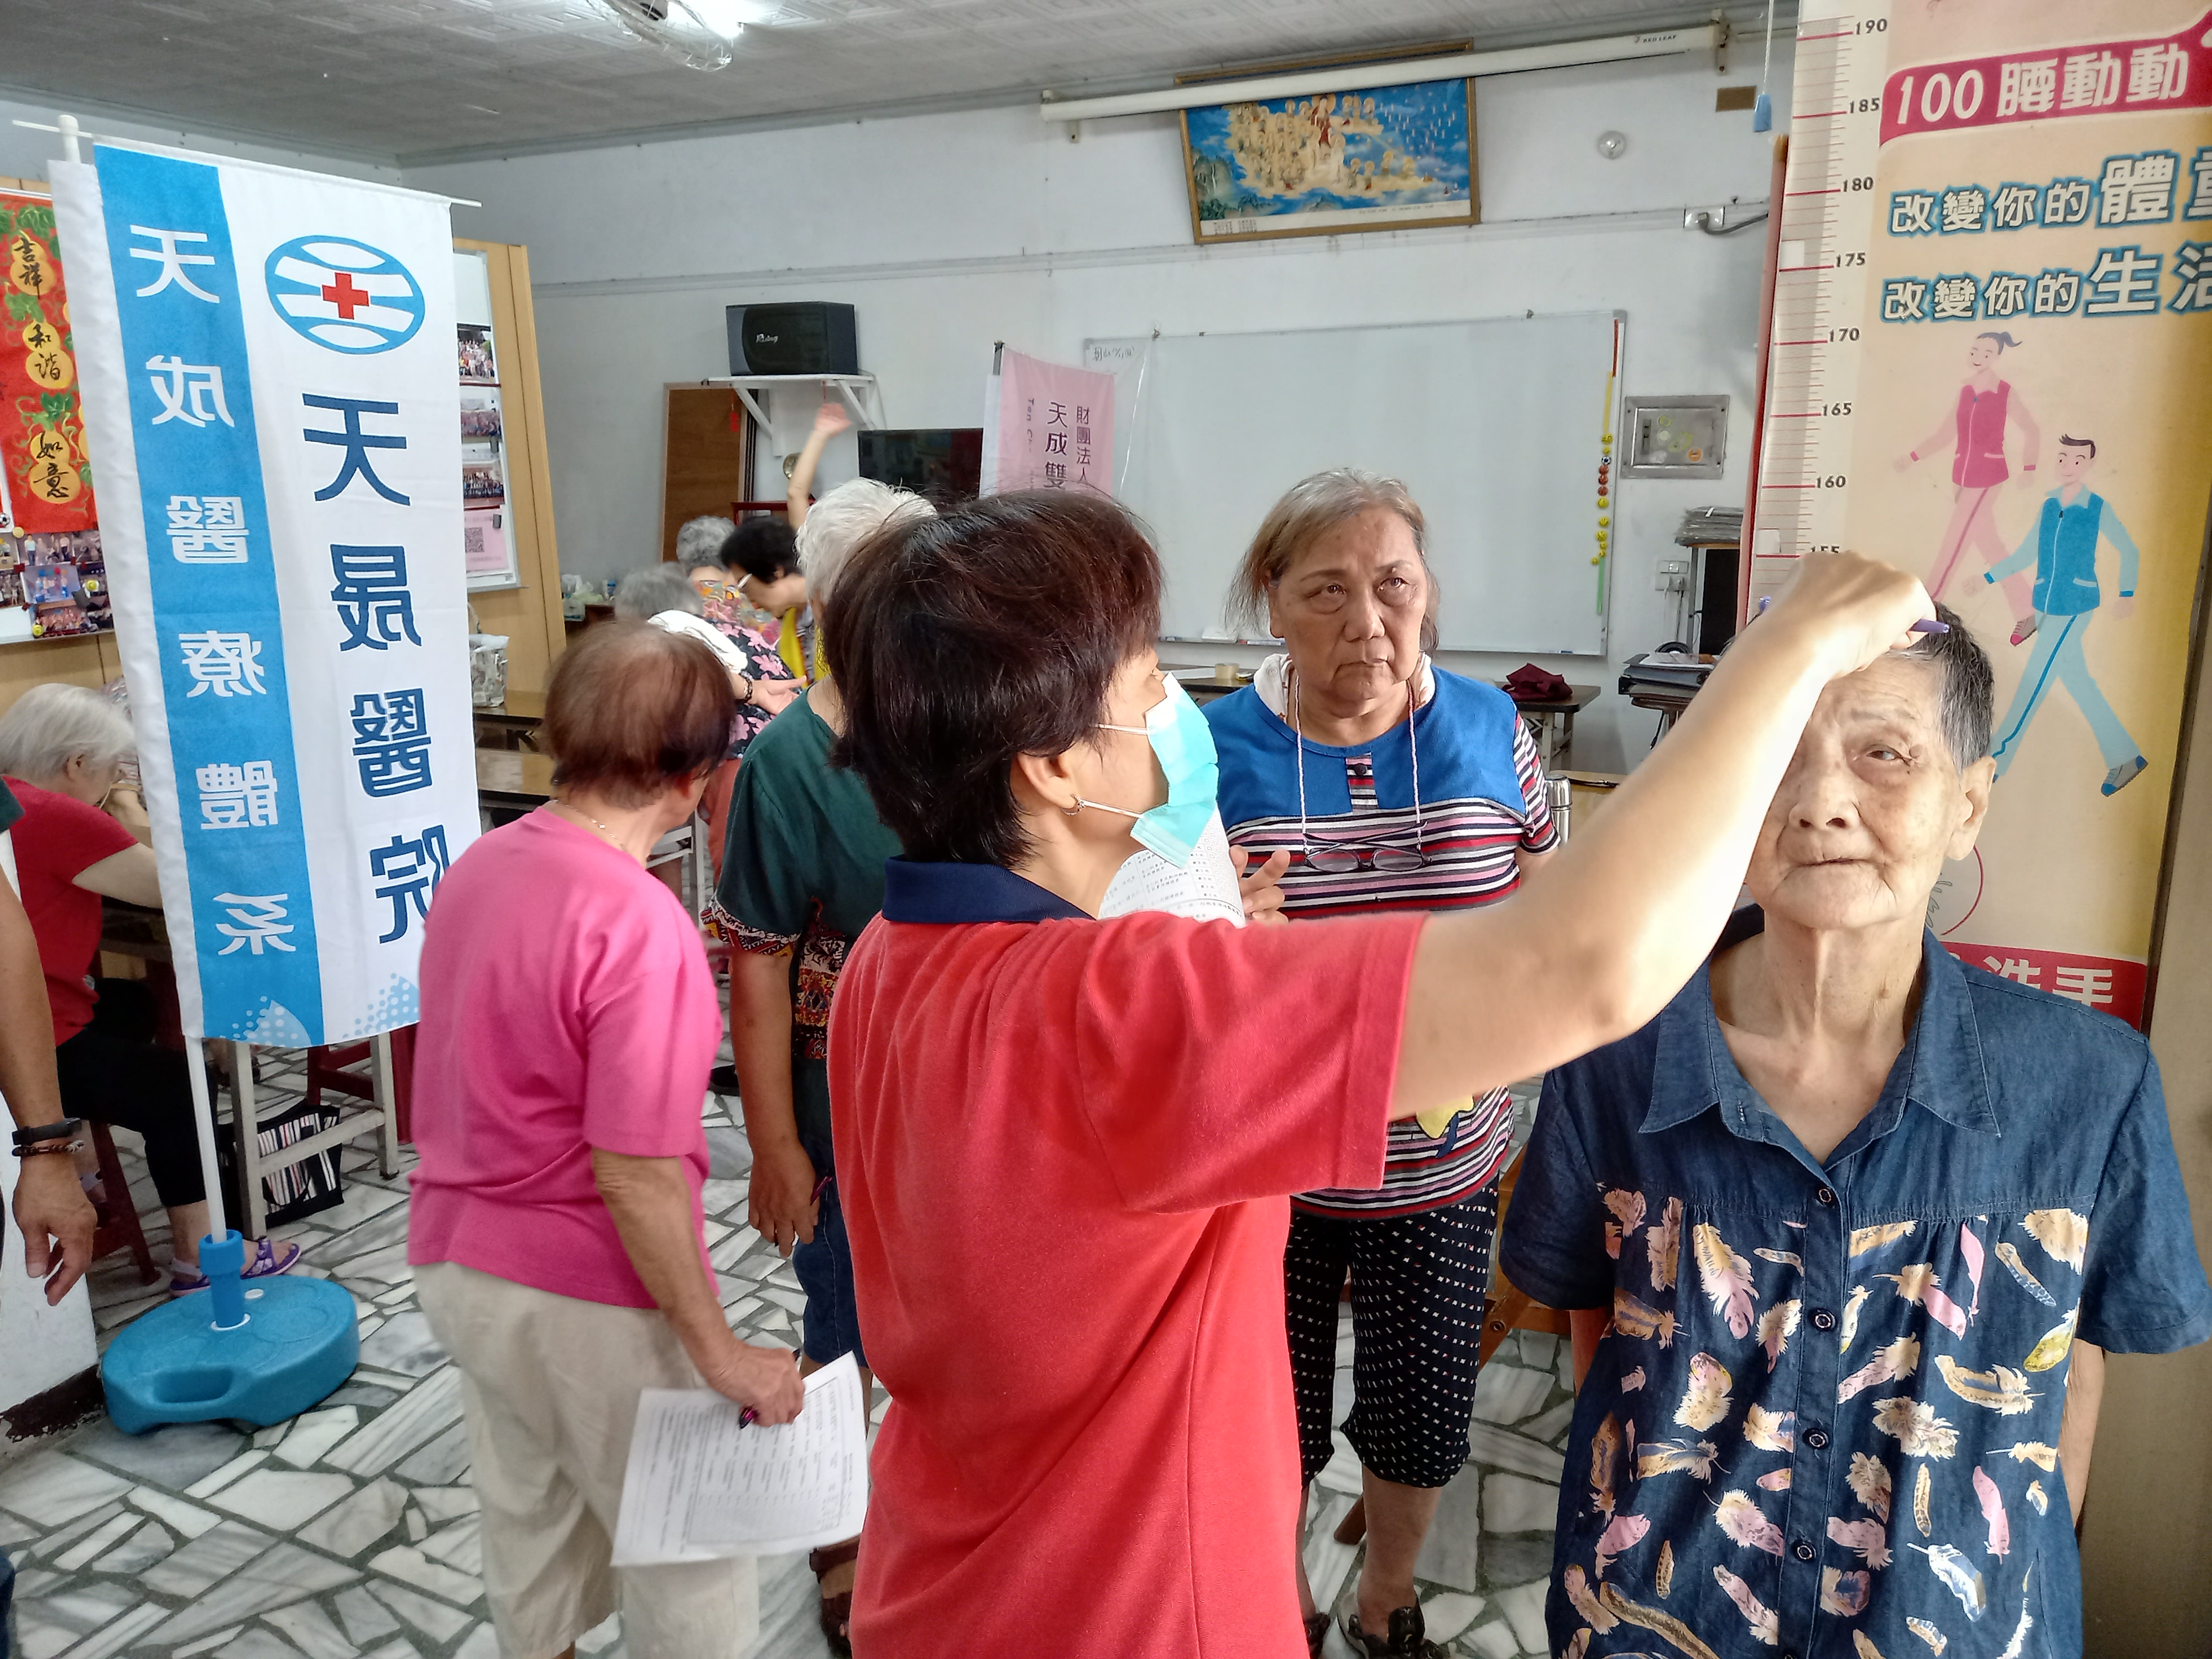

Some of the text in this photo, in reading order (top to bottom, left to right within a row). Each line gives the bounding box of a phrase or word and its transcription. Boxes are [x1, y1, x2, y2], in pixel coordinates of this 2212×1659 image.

[1855, 18, 1887, 35] 190
[1849, 97, 1880, 114] 185
[1896, 70, 1984, 124] 100
[1843, 176, 1874, 192] 180
[14, 237, 43, 299] 吉祥
[1835, 252, 1866, 267] 175
[1828, 327, 1860, 343] 170
[28, 323, 61, 381] 和諧
[1822, 402, 1852, 418] 165
[1076, 405, 1091, 484] 財團法人
[33, 430, 69, 498] 如意
[1815, 475, 1846, 489] 160
